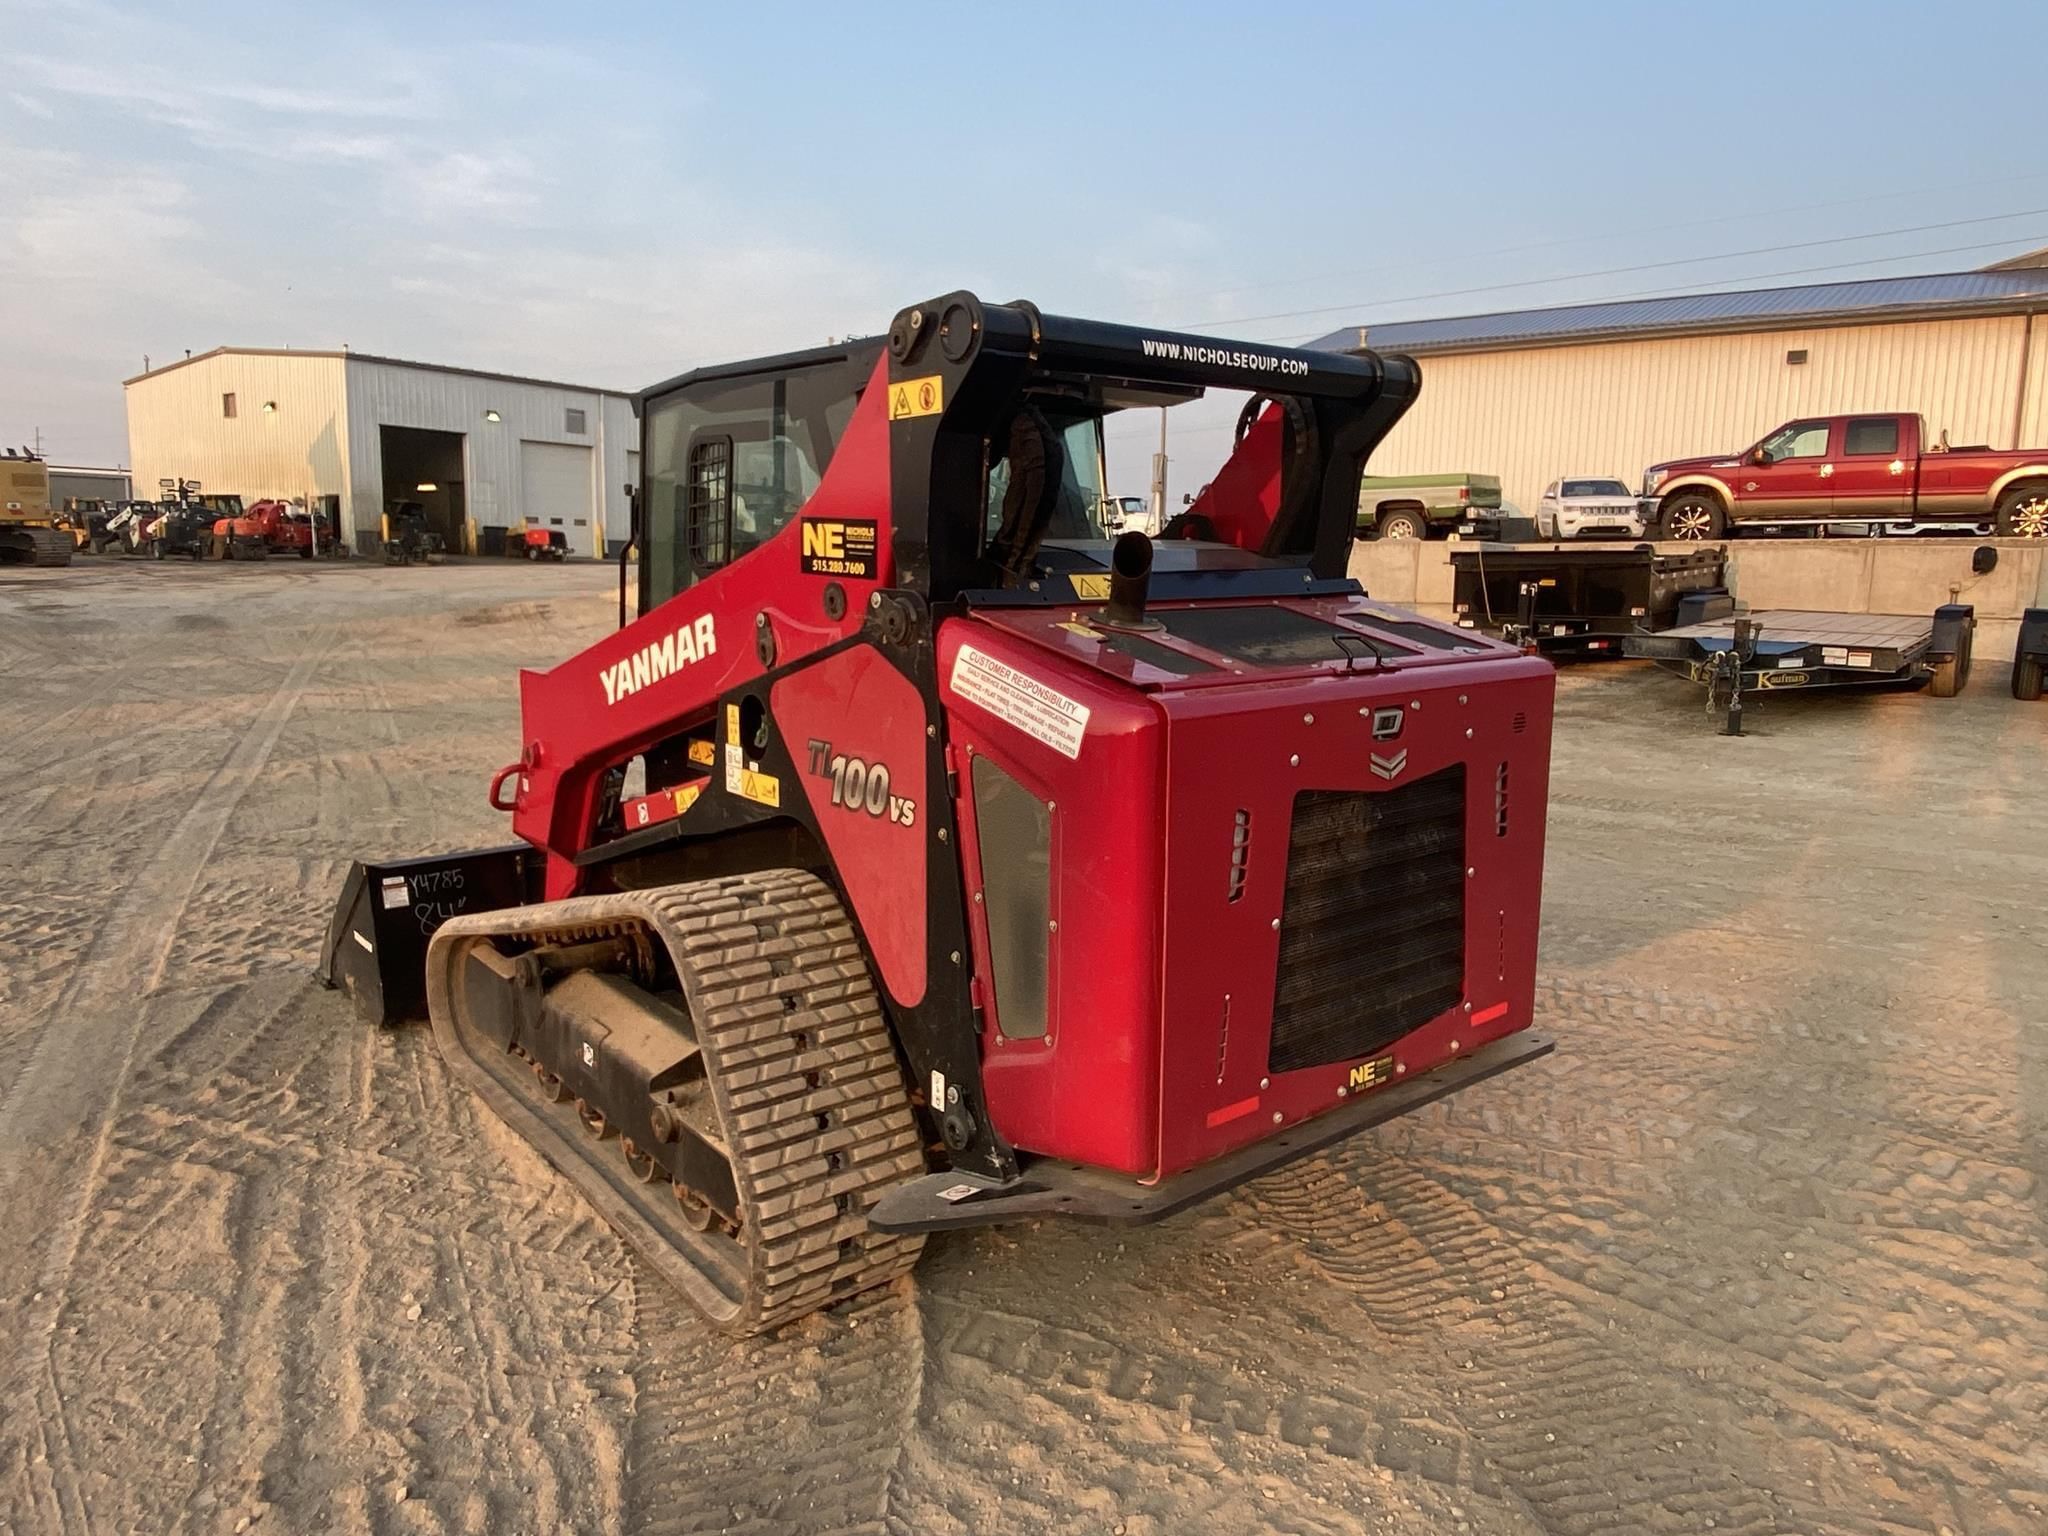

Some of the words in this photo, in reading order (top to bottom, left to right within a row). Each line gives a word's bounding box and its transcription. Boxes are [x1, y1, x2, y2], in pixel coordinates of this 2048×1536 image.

[1142, 339, 1309, 376] WWW.NICHOLSEQUIP.COM
[803, 522, 844, 558] NE
[600, 613, 717, 706] YANMAR
[969, 651, 1010, 680] CUSTOMER
[1011, 673, 1078, 715] RESPONSIBILITY
[1757, 671, 1805, 689] Kaufman
[409, 868, 464, 898] Y4785
[1350, 1061, 1376, 1087] NE
